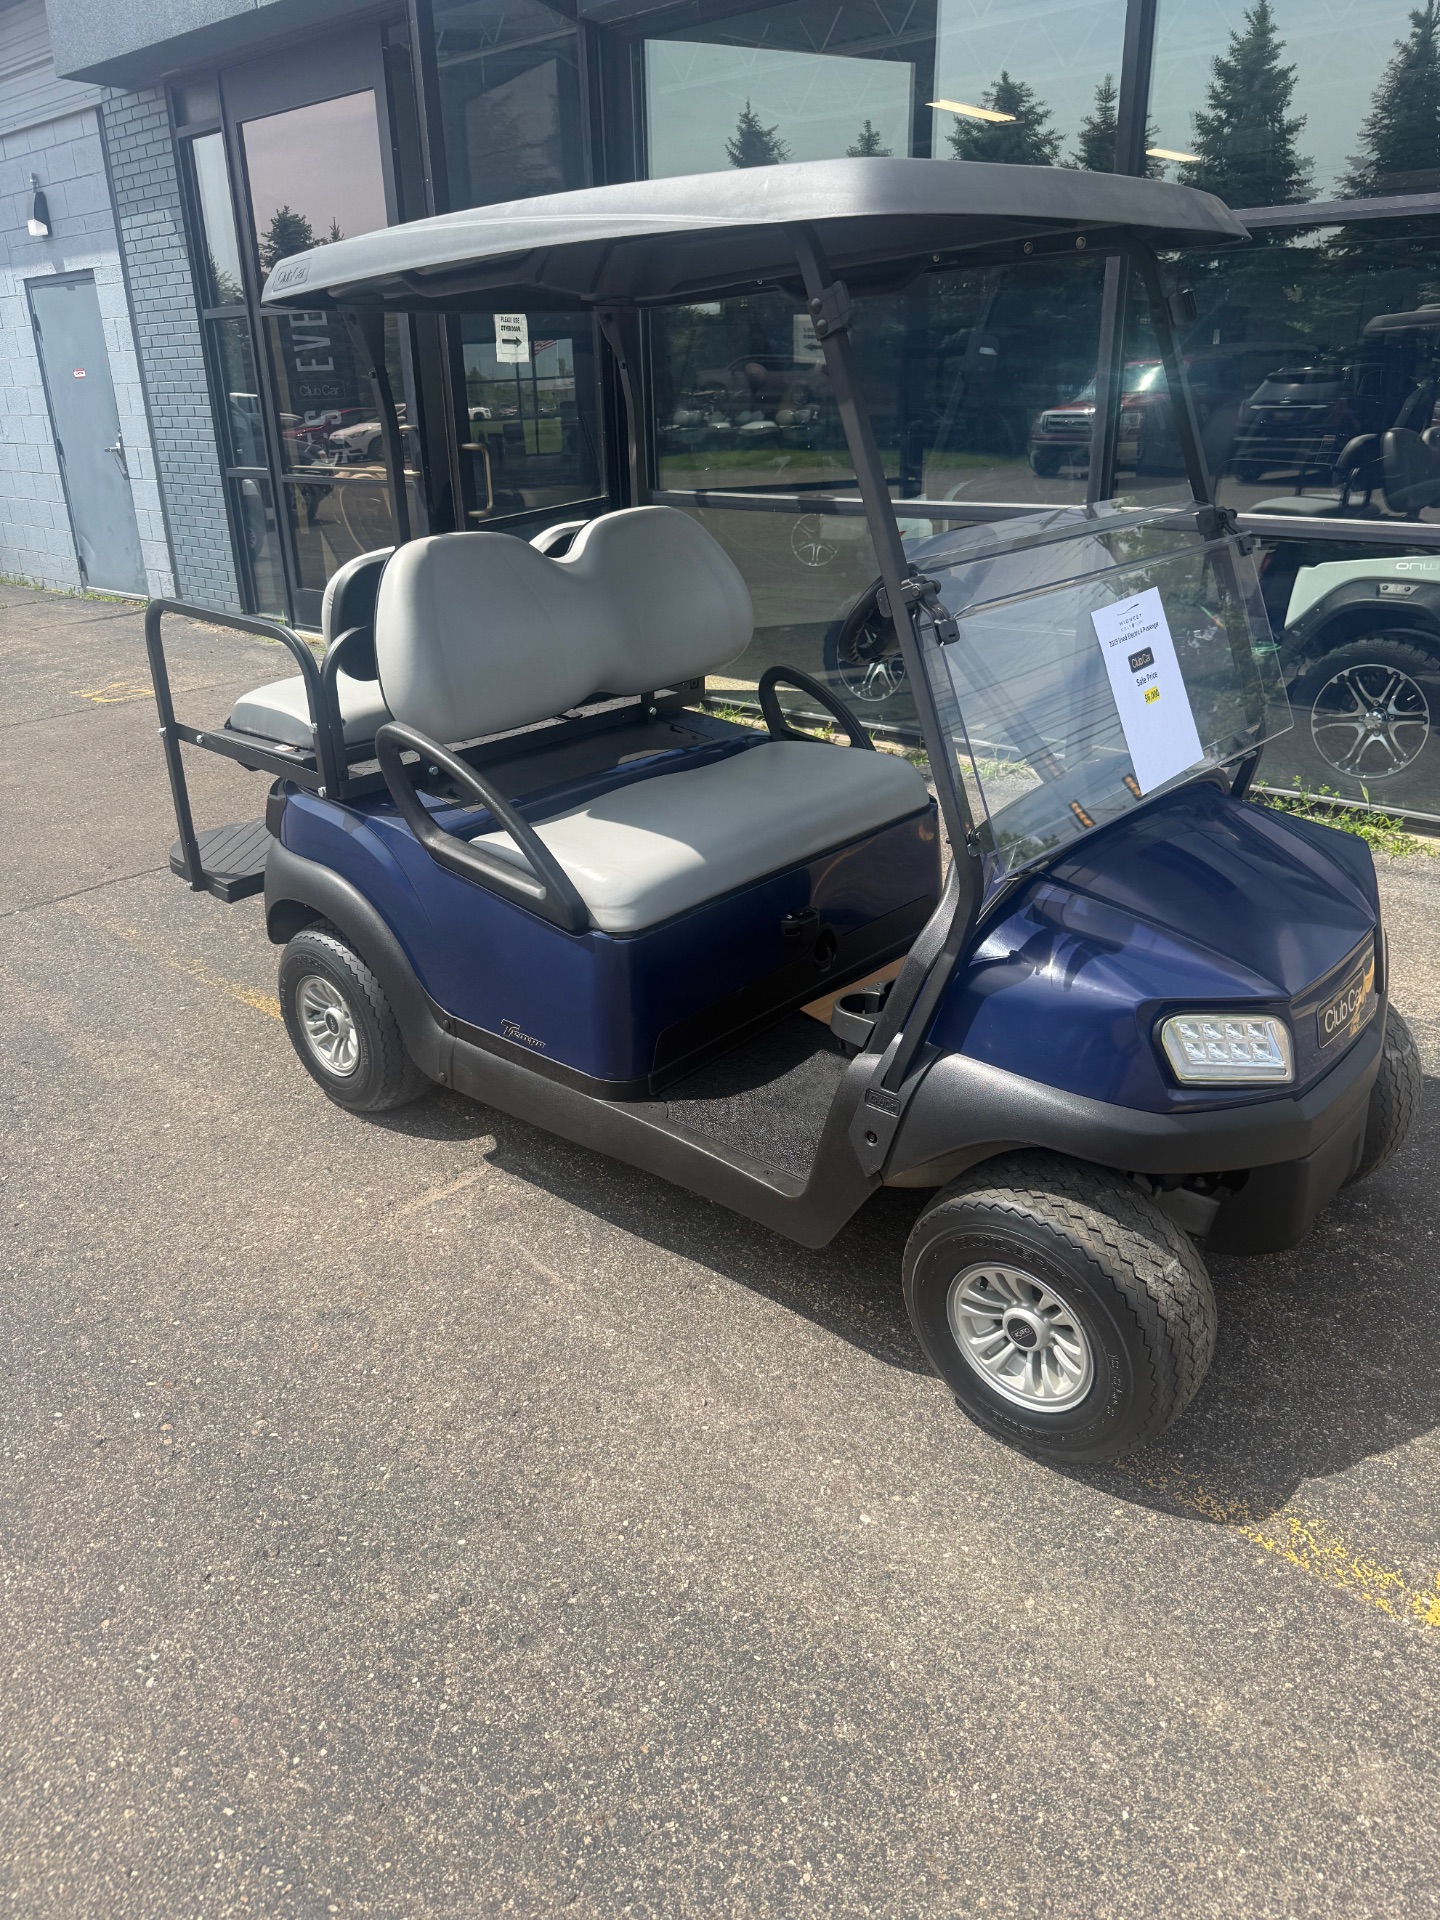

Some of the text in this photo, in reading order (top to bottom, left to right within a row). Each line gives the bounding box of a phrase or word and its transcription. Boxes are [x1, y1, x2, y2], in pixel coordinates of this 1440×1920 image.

[299, 385, 340, 397] Club Car
[1131, 656, 1144, 669] Club
[1136, 671, 1158, 687] Sale Price
[1325, 986, 1363, 1033] Club Car
[500, 1018, 547, 1049] Tempo
